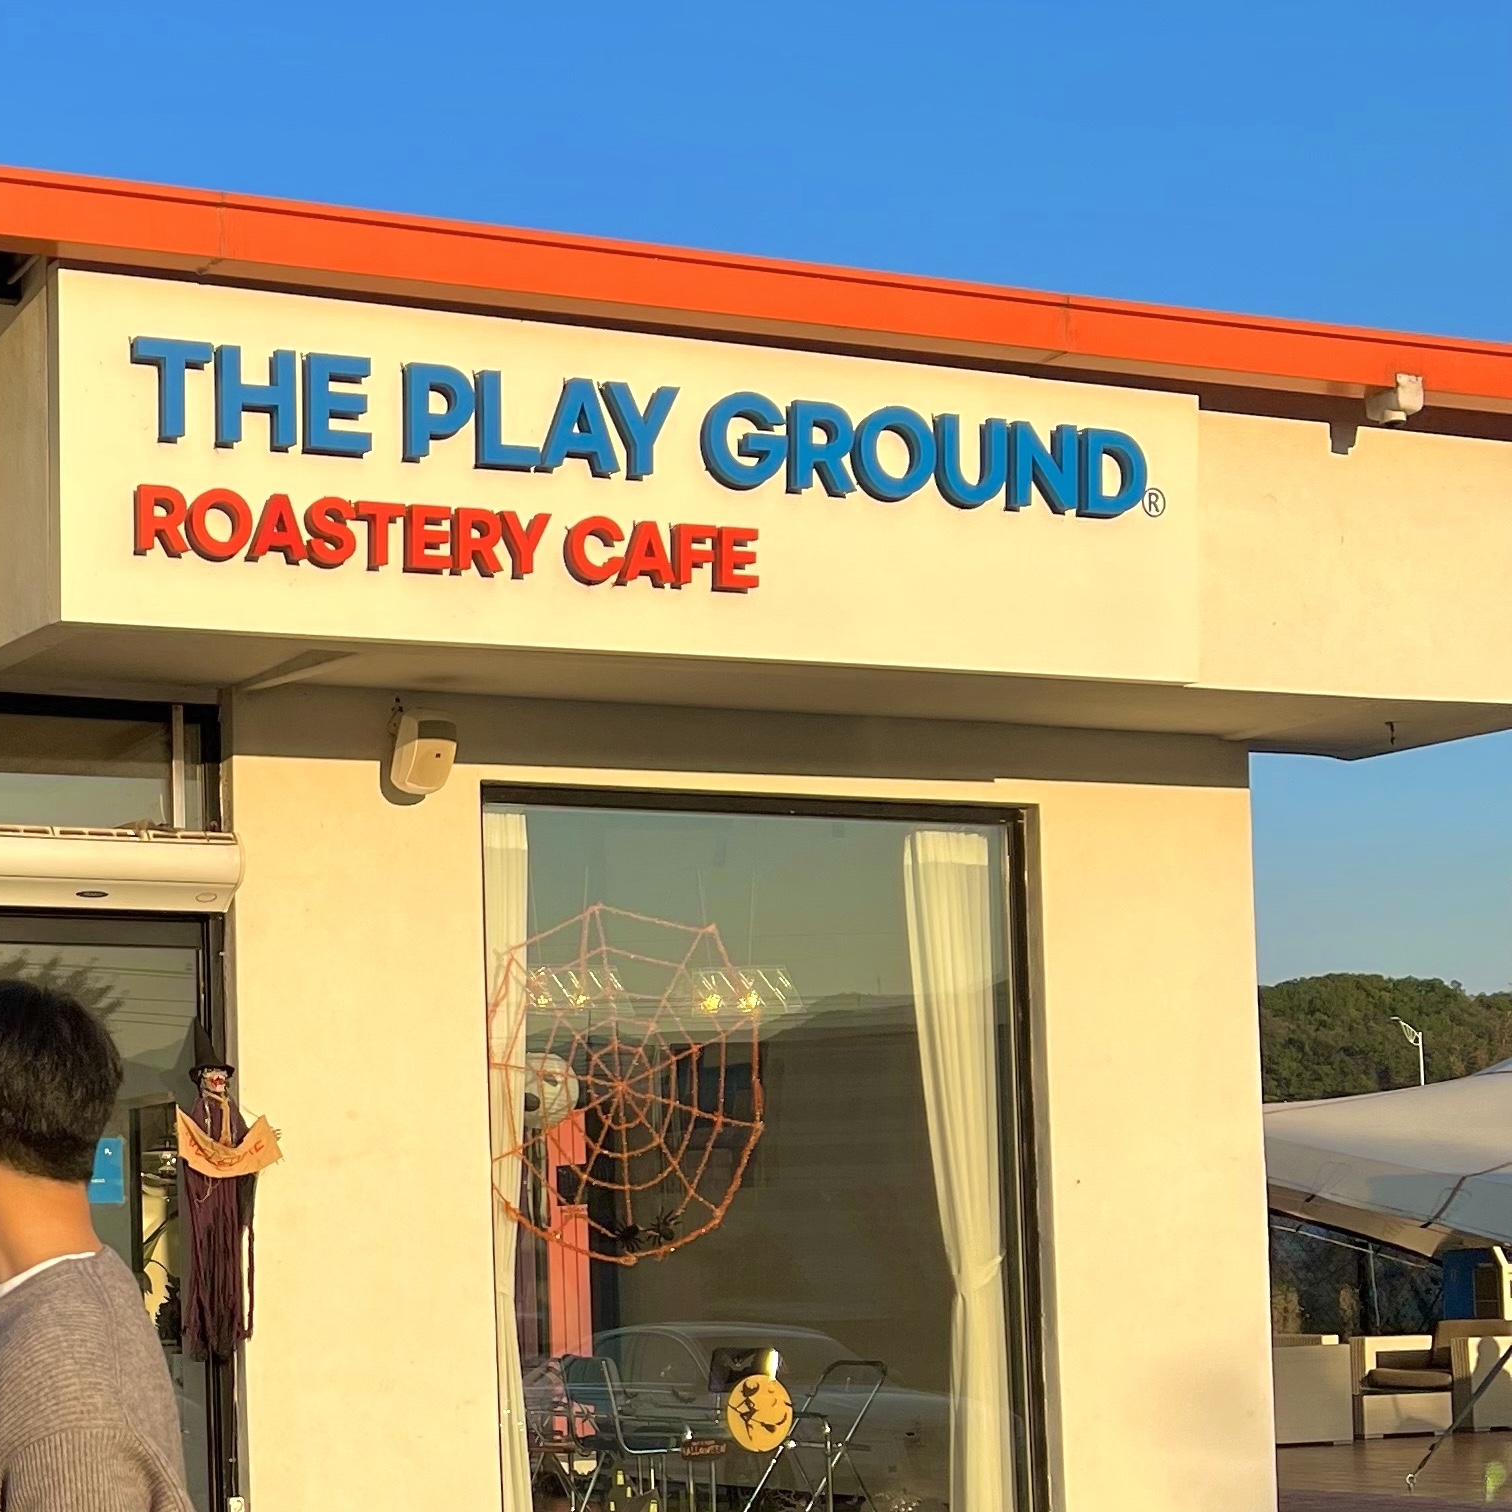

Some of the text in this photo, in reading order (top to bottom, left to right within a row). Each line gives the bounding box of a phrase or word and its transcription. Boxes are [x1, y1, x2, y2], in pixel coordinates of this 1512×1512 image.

[129, 335, 372, 459] THE
[401, 361, 681, 480] PLAY
[133, 483, 759, 593] ROASTERY CAFE
